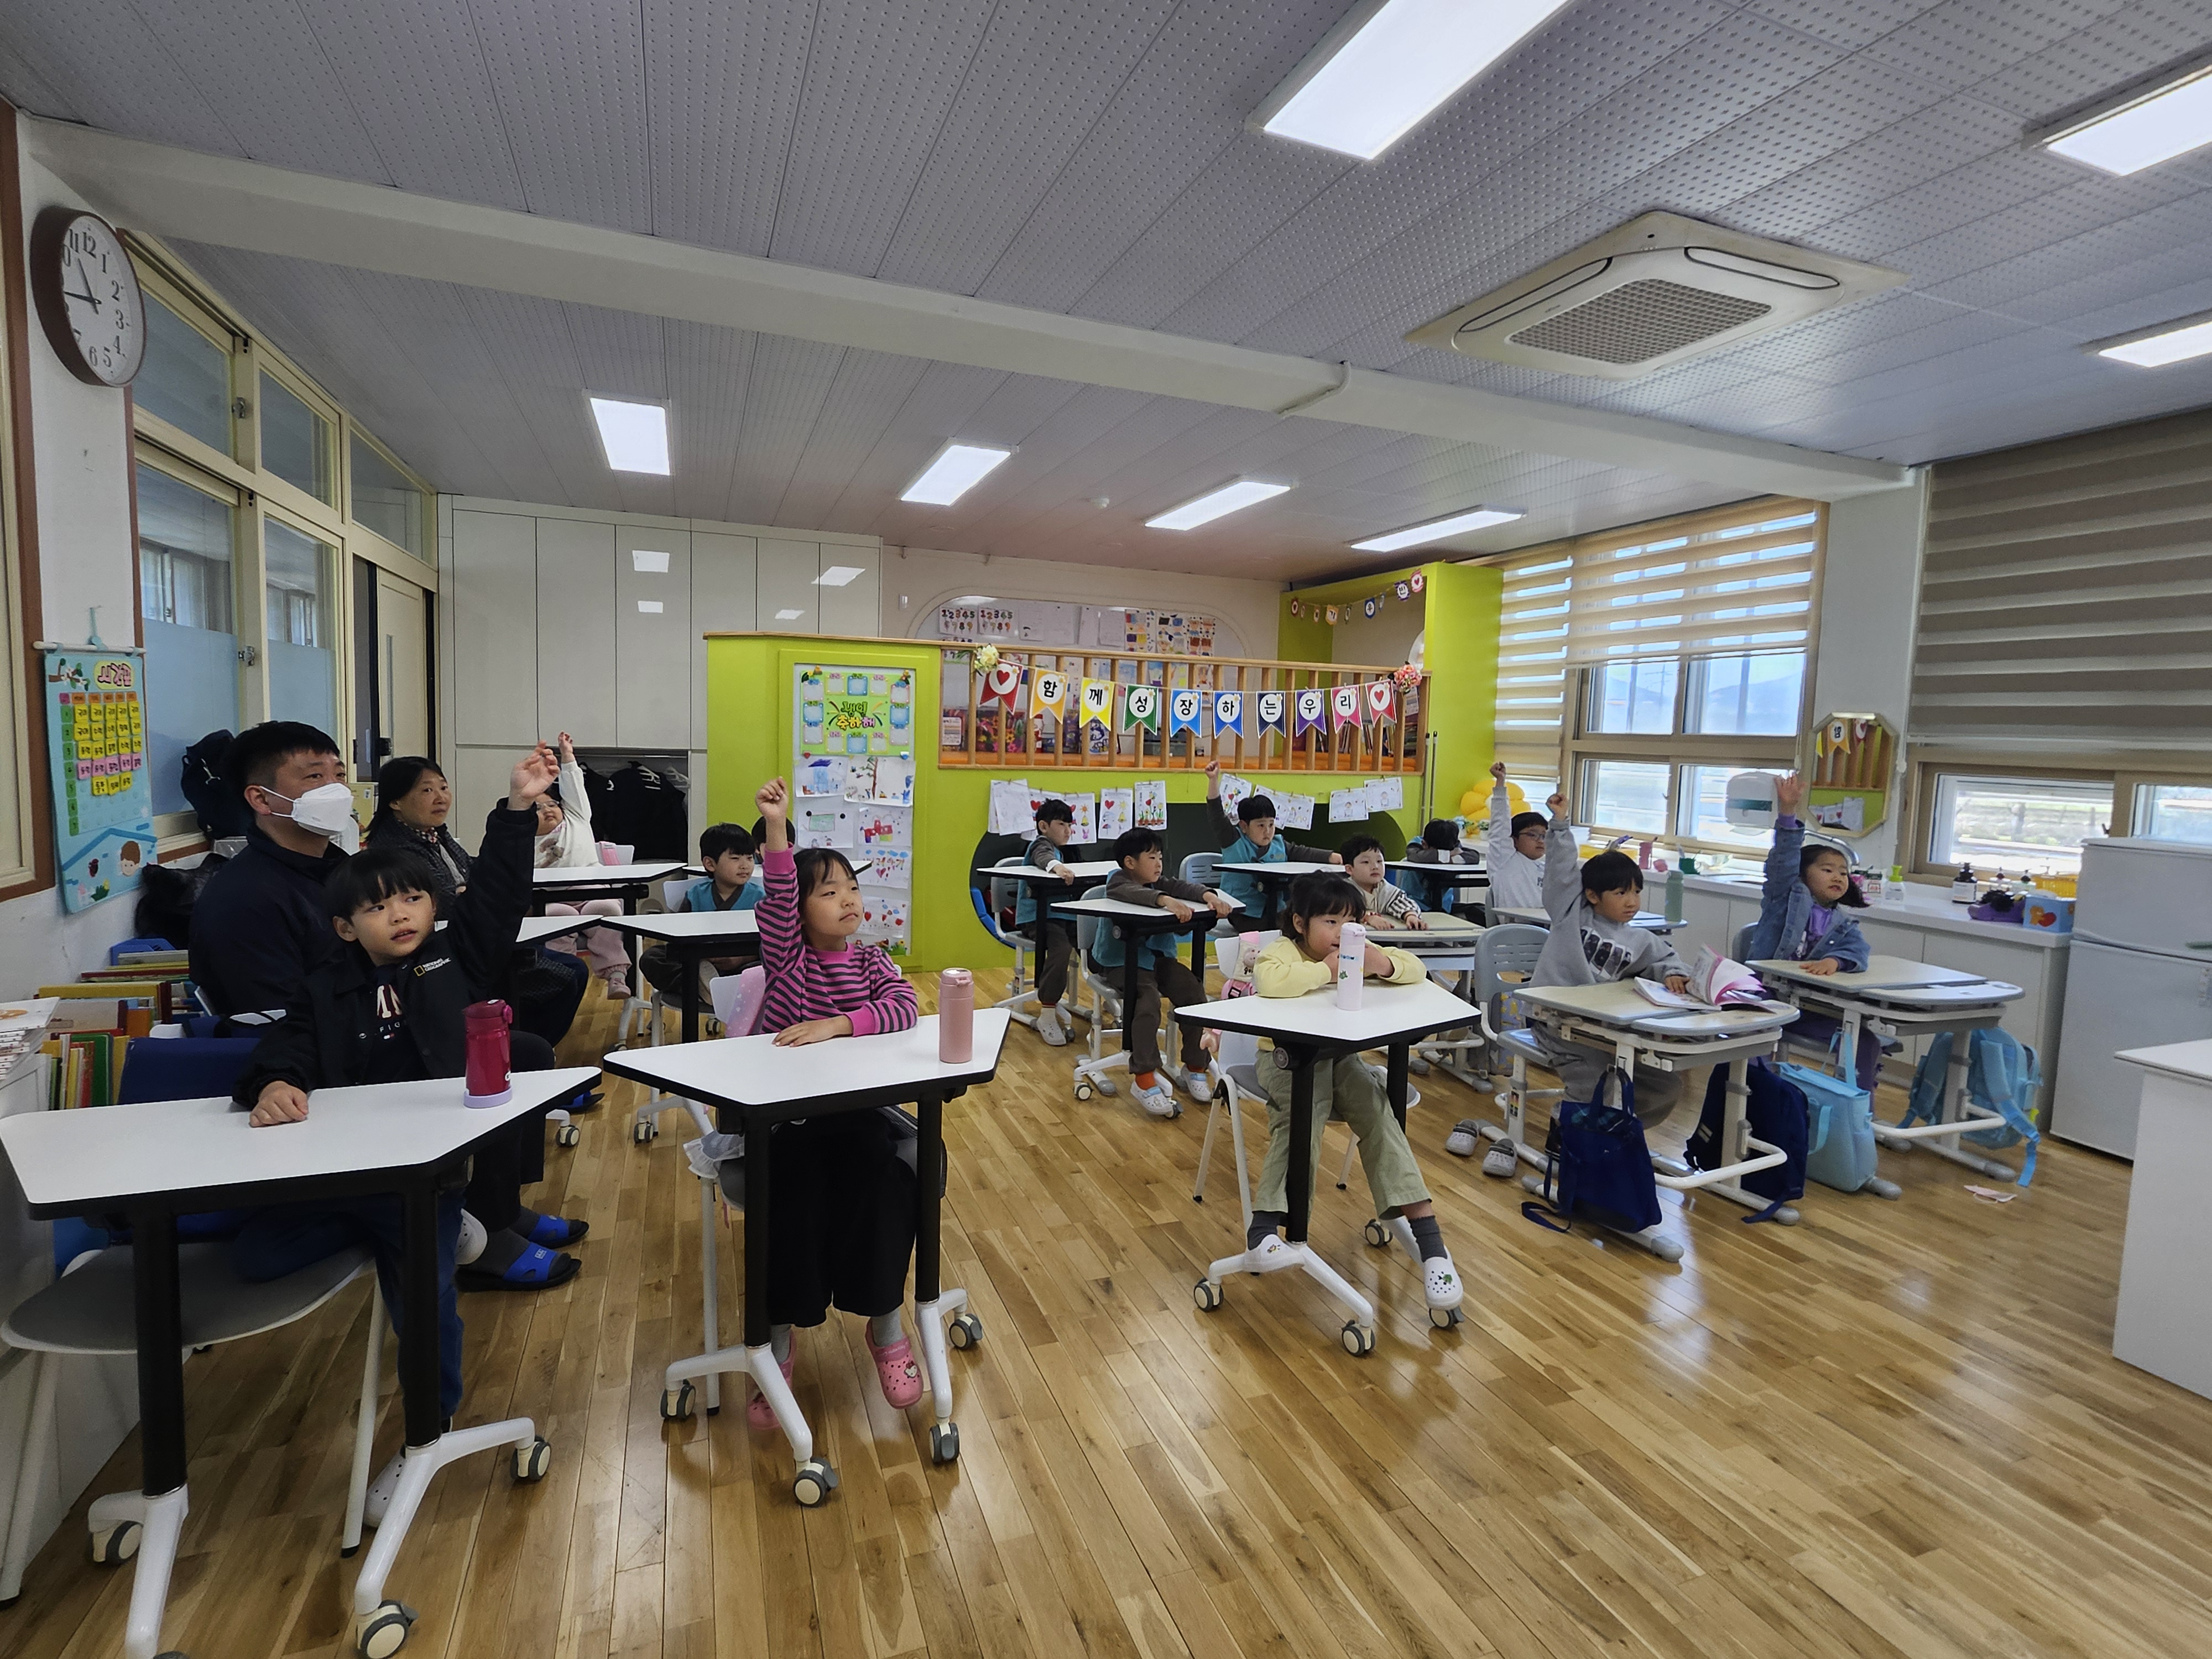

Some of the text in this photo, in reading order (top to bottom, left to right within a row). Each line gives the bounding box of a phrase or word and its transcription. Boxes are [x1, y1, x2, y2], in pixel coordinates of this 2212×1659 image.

[70, 228, 79, 254] 11
[82, 231, 97, 258] 12
[102, 253, 107, 274] 1
[112, 280, 120, 302] 2
[116, 310, 124, 330] 3
[113, 335, 121, 355] 4
[89, 346, 98, 367] 6
[103, 347, 112, 368] 5
[836, 714, 875, 731] 축하해
